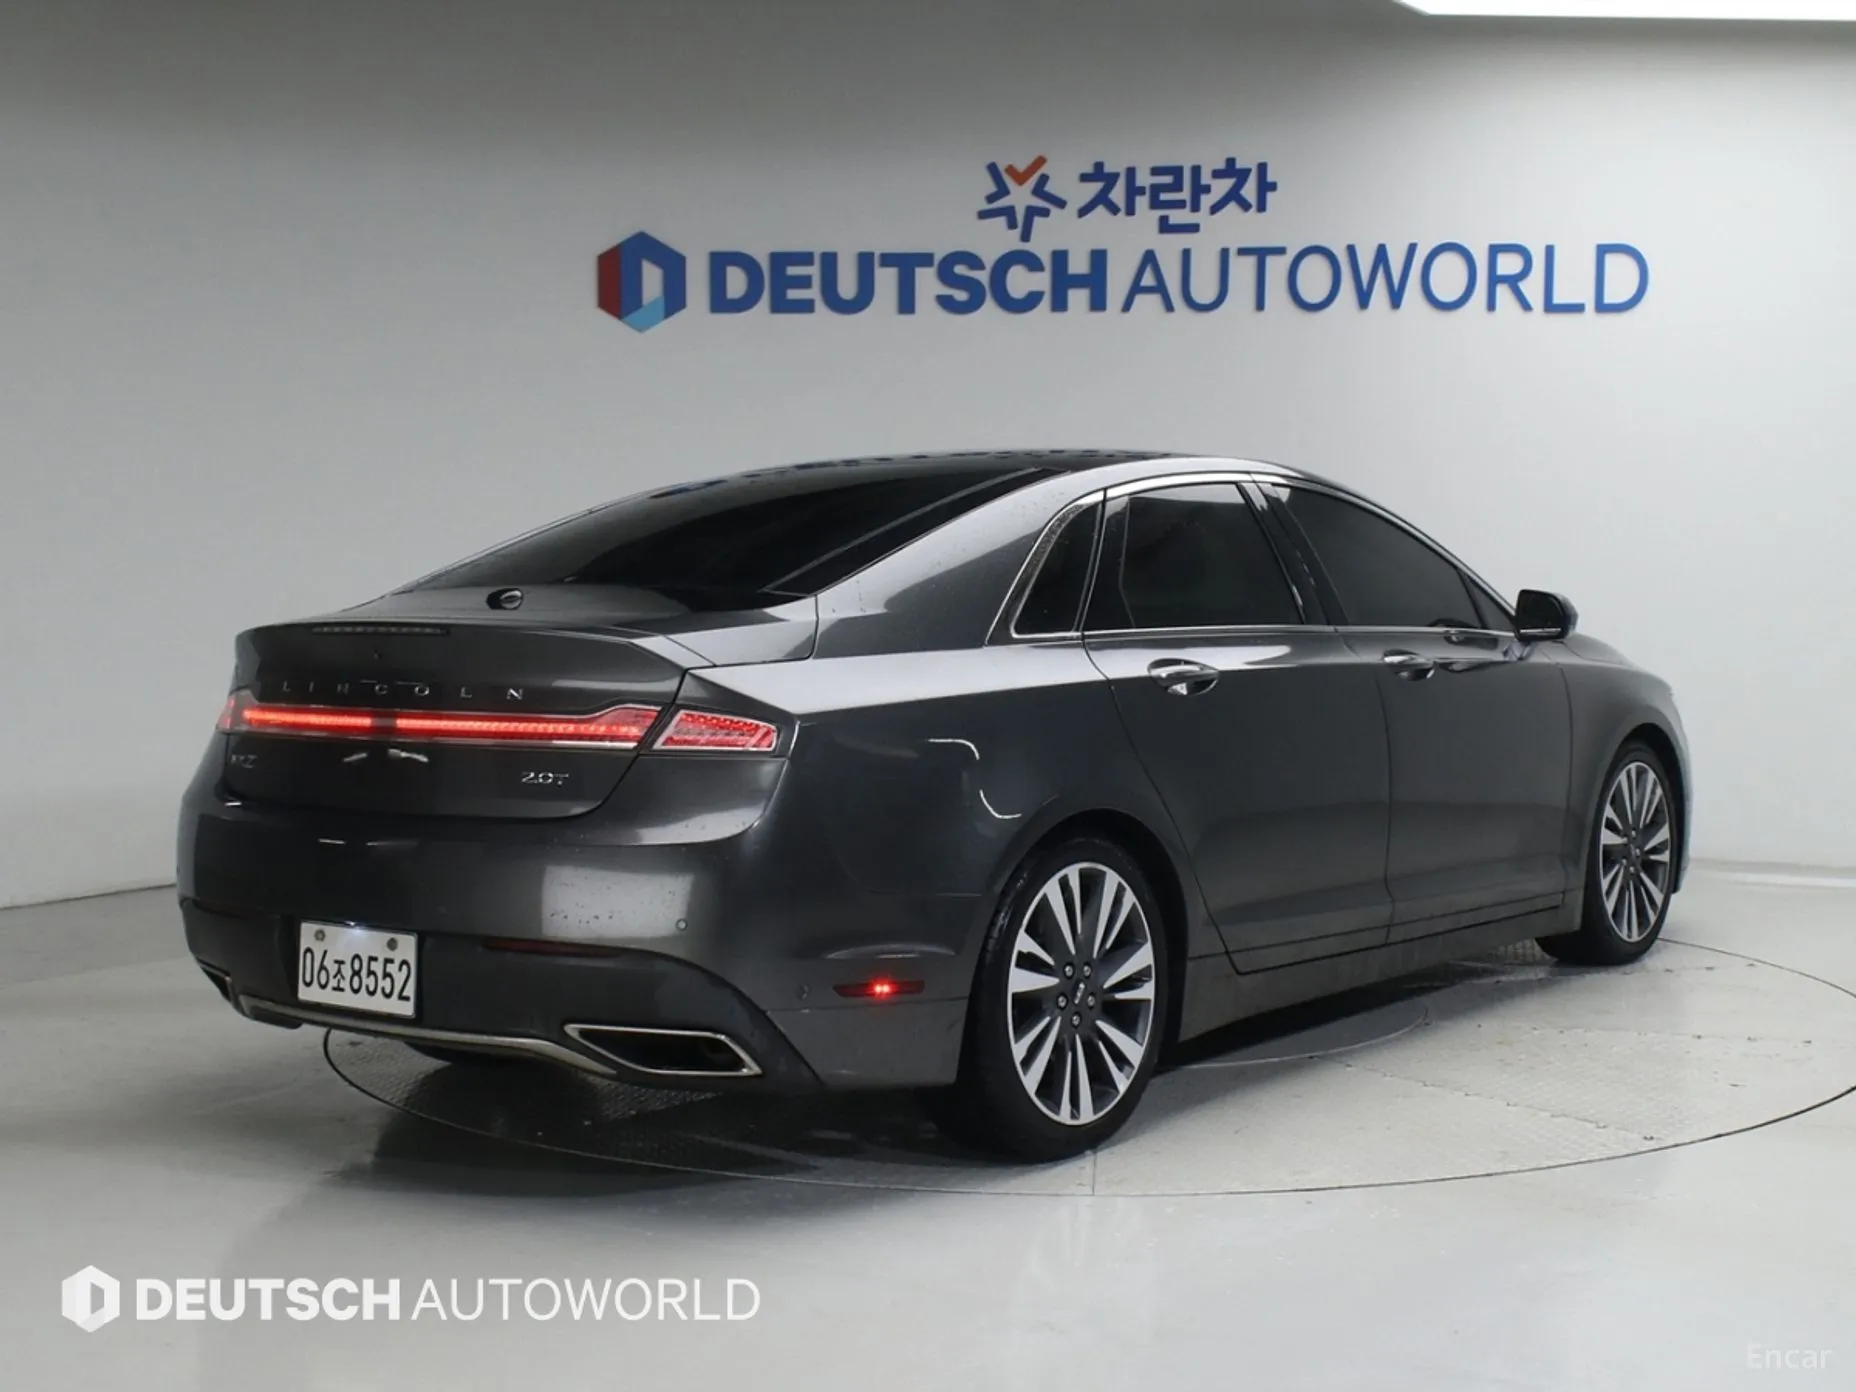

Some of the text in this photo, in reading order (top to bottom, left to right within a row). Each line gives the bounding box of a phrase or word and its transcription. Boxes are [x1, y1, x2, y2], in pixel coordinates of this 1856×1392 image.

[1077, 157, 1278, 234] 차란차
[708, 242, 1650, 315] DEUTSCH AUTOWORLD
[282, 680, 524, 700] LINCOLN
[302, 946, 412, 1002] 06조8552
